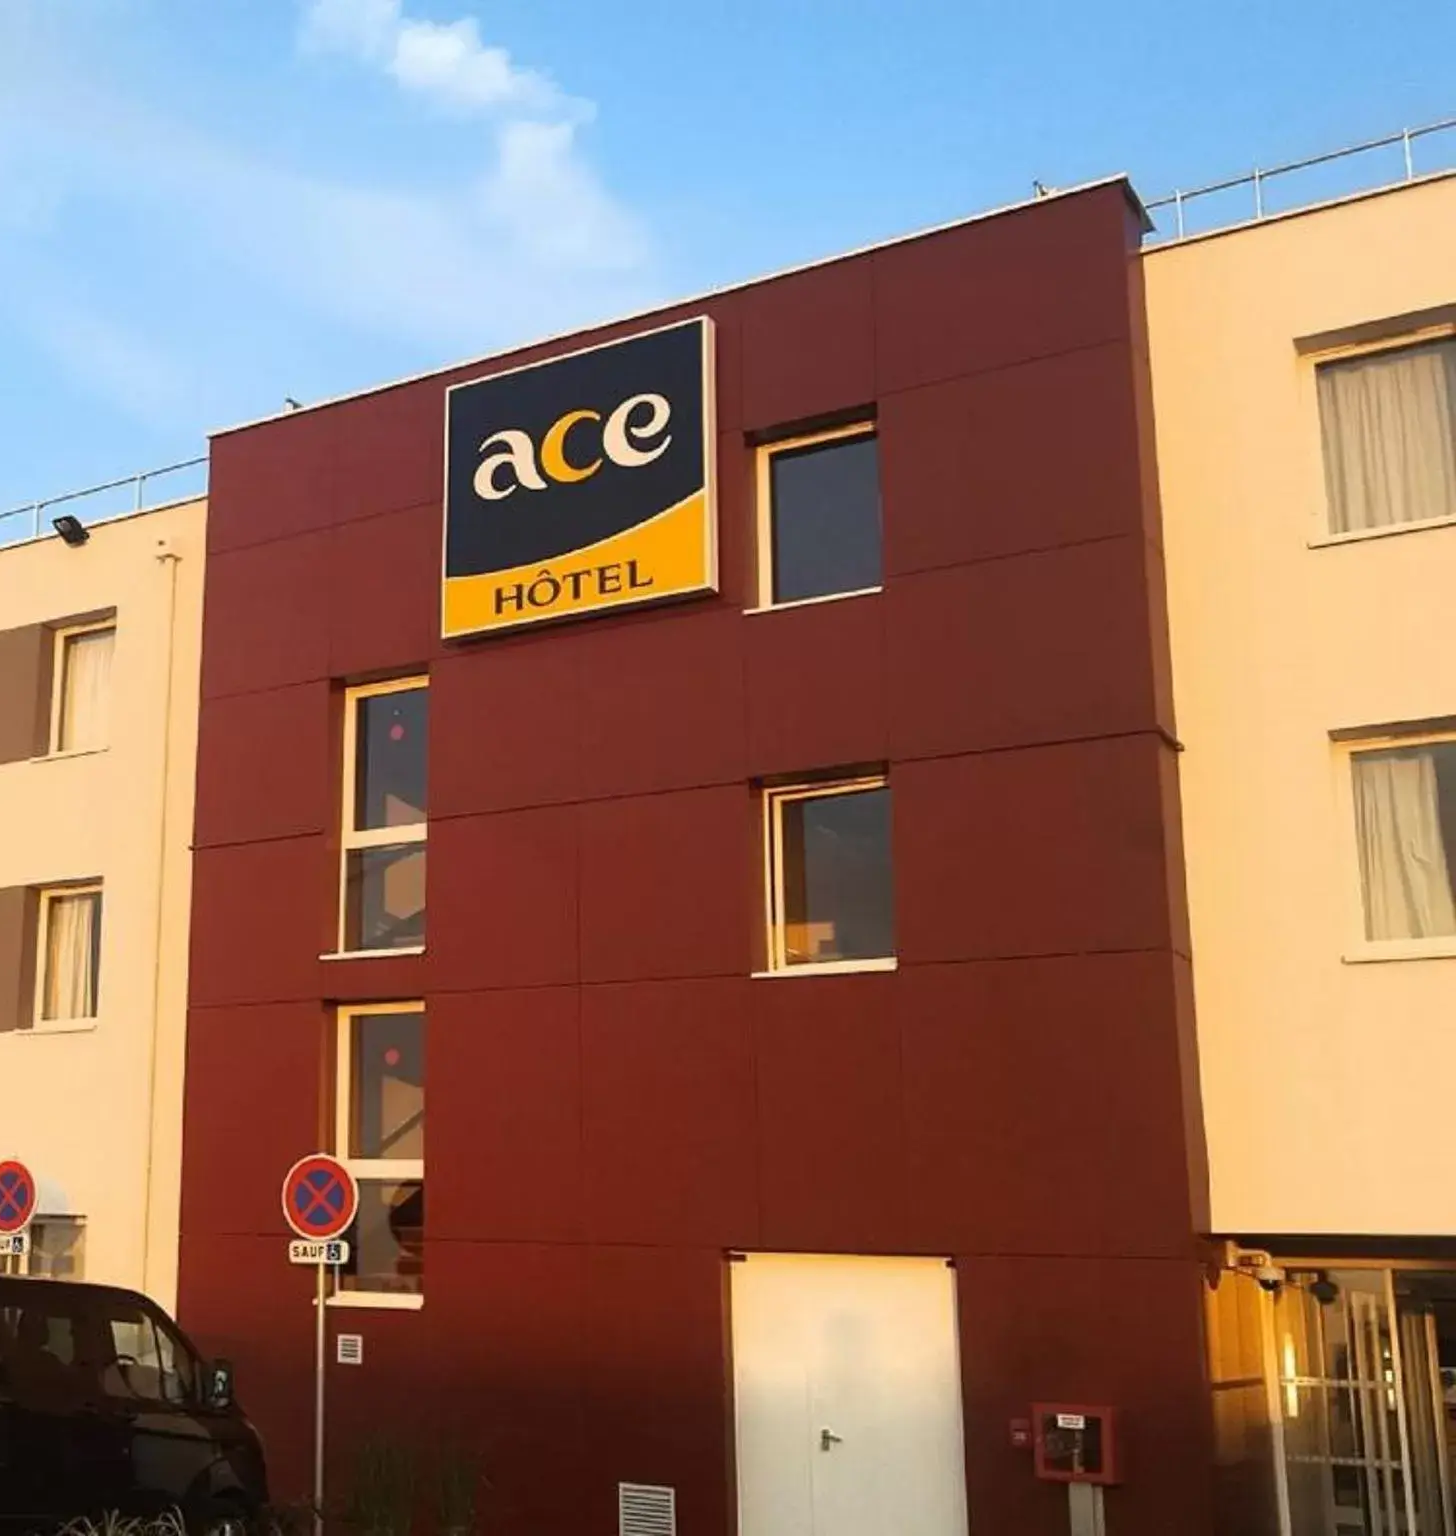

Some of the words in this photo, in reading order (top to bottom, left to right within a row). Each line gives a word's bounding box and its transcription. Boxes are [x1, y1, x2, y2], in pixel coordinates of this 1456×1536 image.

[473, 393, 672, 500] ace
[494, 559, 654, 615] HÔTEL
[293, 1245, 324, 1258] SAUF
